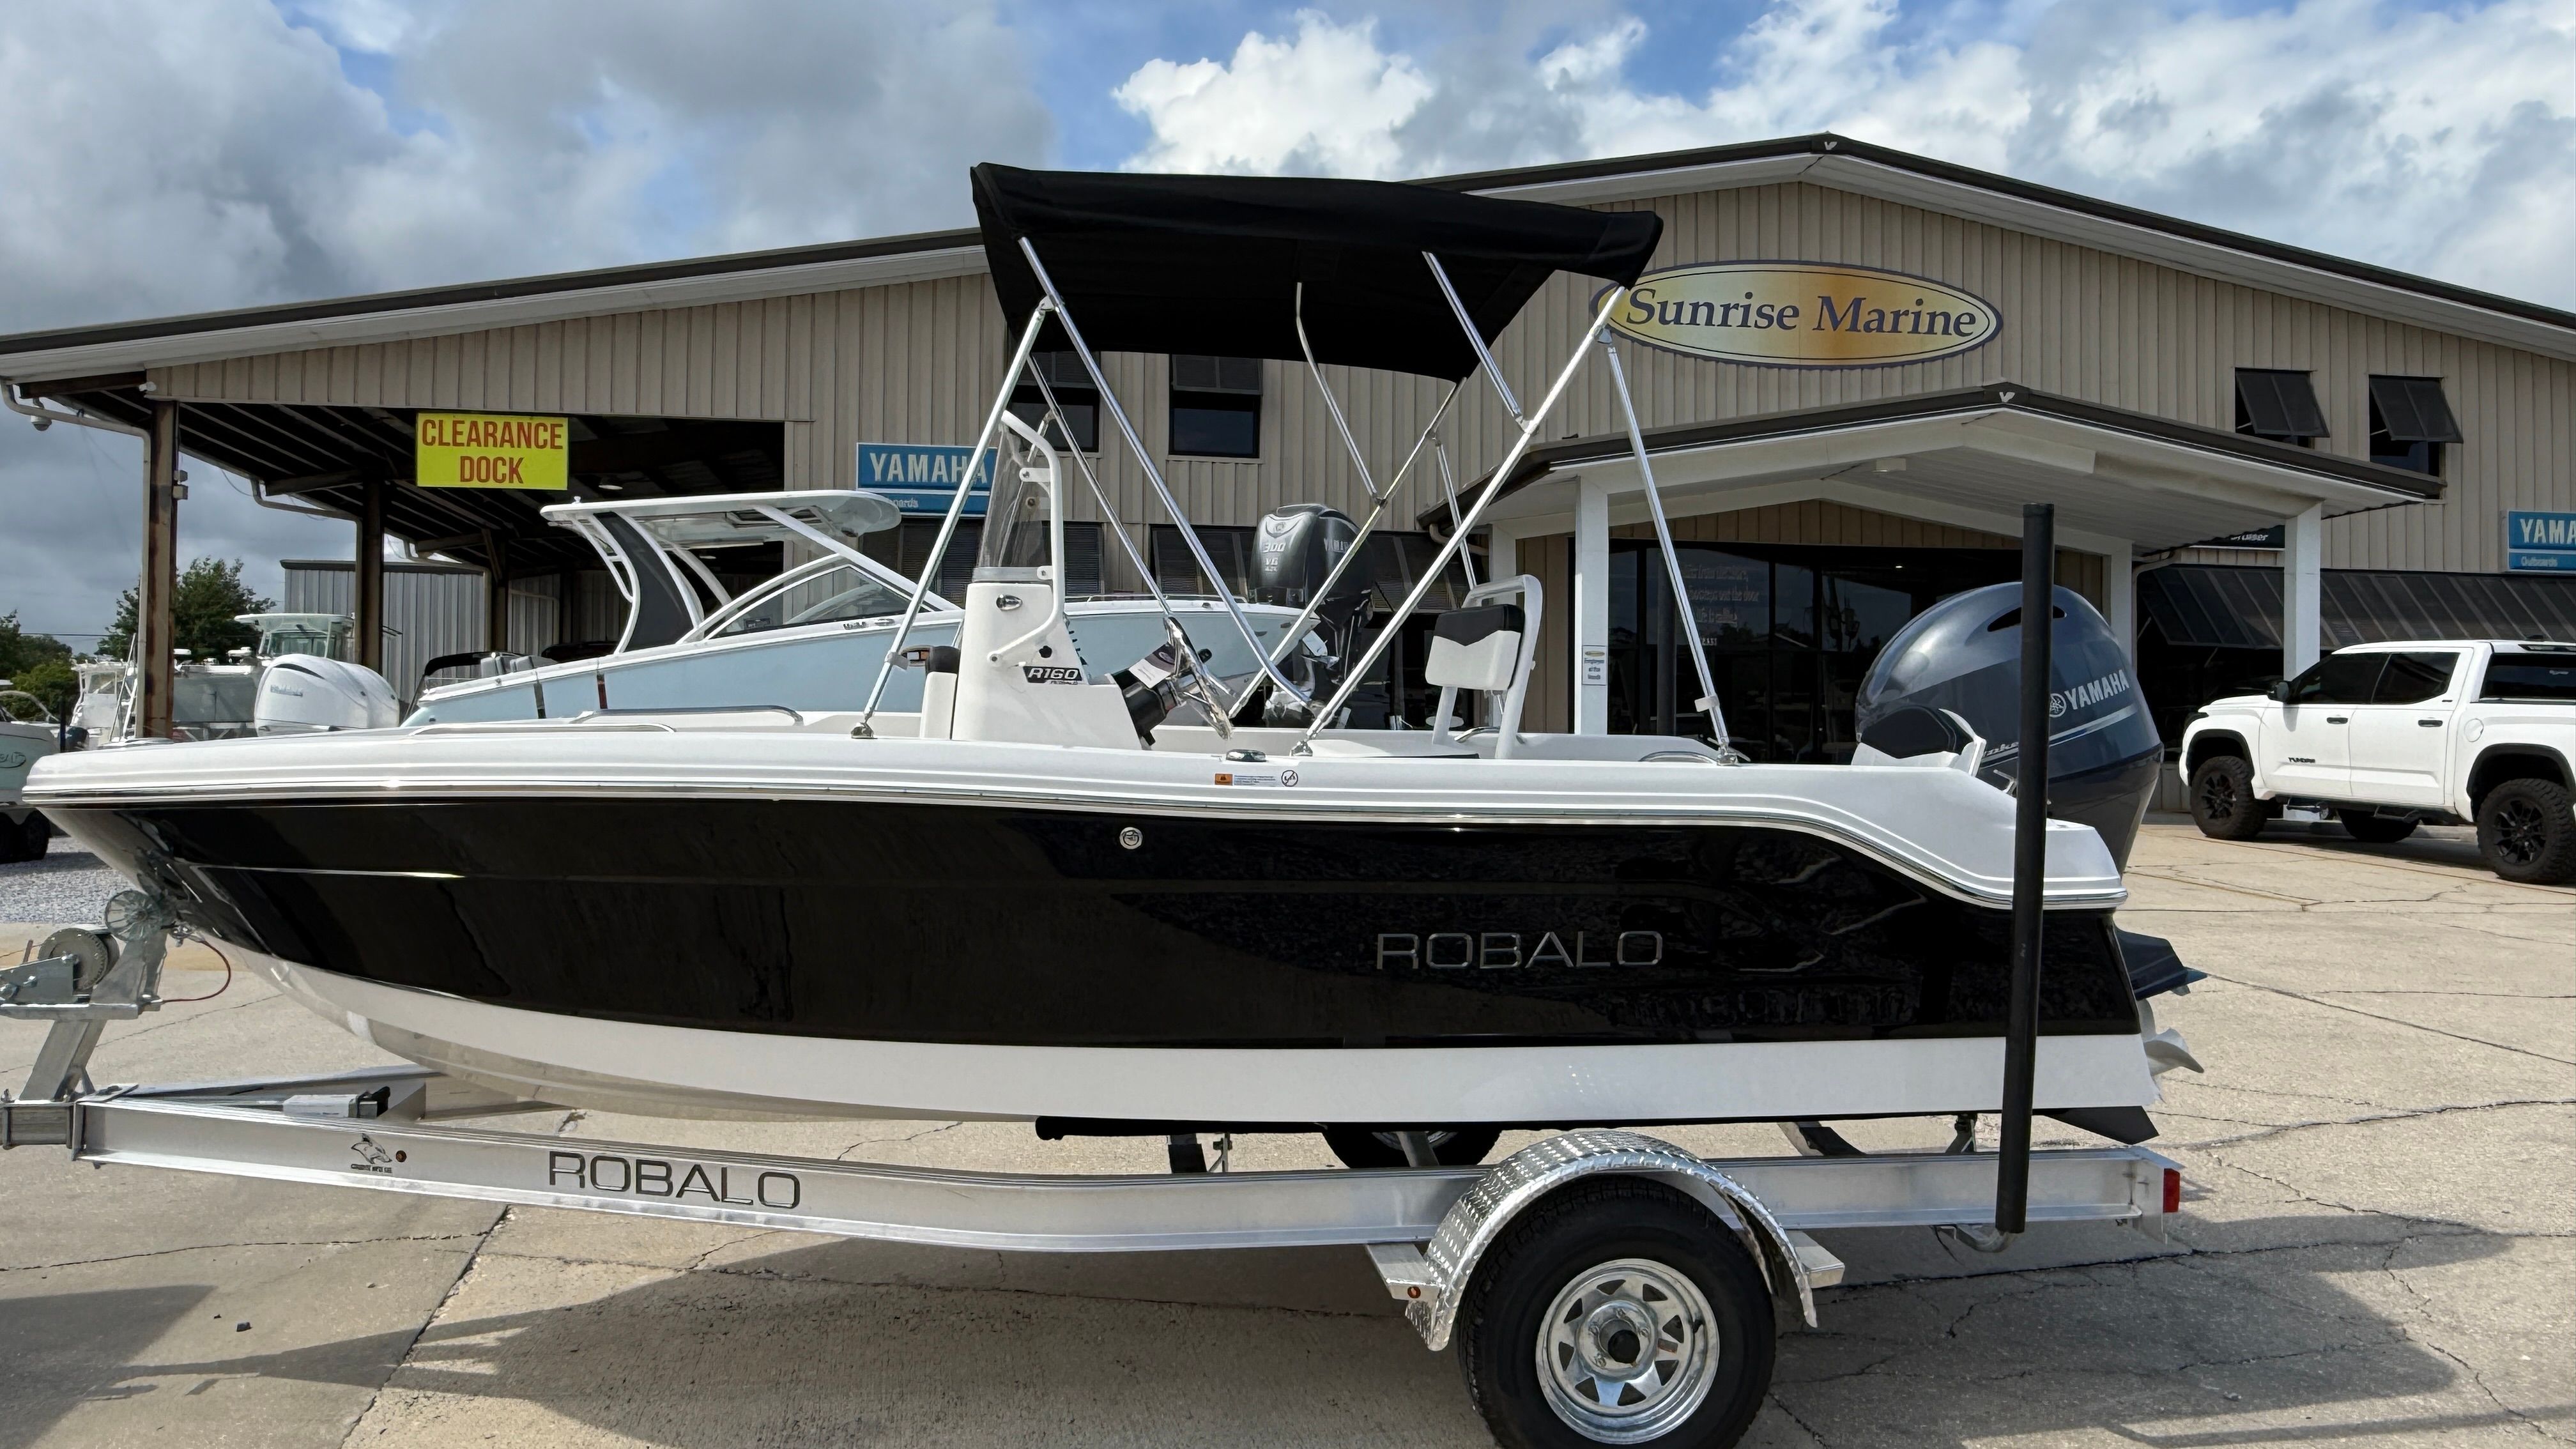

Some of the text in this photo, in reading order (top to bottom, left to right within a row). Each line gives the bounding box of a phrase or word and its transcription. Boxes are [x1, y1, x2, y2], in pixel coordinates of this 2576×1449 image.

[1625, 288, 1977, 337] Sunrise Marine
[422, 418, 564, 450] CLEARANCE
[459, 456, 525, 484] DOCK
[869, 452, 988, 484] YAMAHA
[2519, 518, 2576, 544] YAMA
[1262, 542, 1286, 553] 300
[1027, 667, 1079, 680] R160
[2064, 669, 2130, 710] YAMAHA
[1376, 930, 1664, 970] ROBALO
[549, 1150, 801, 1209] ROBALO
